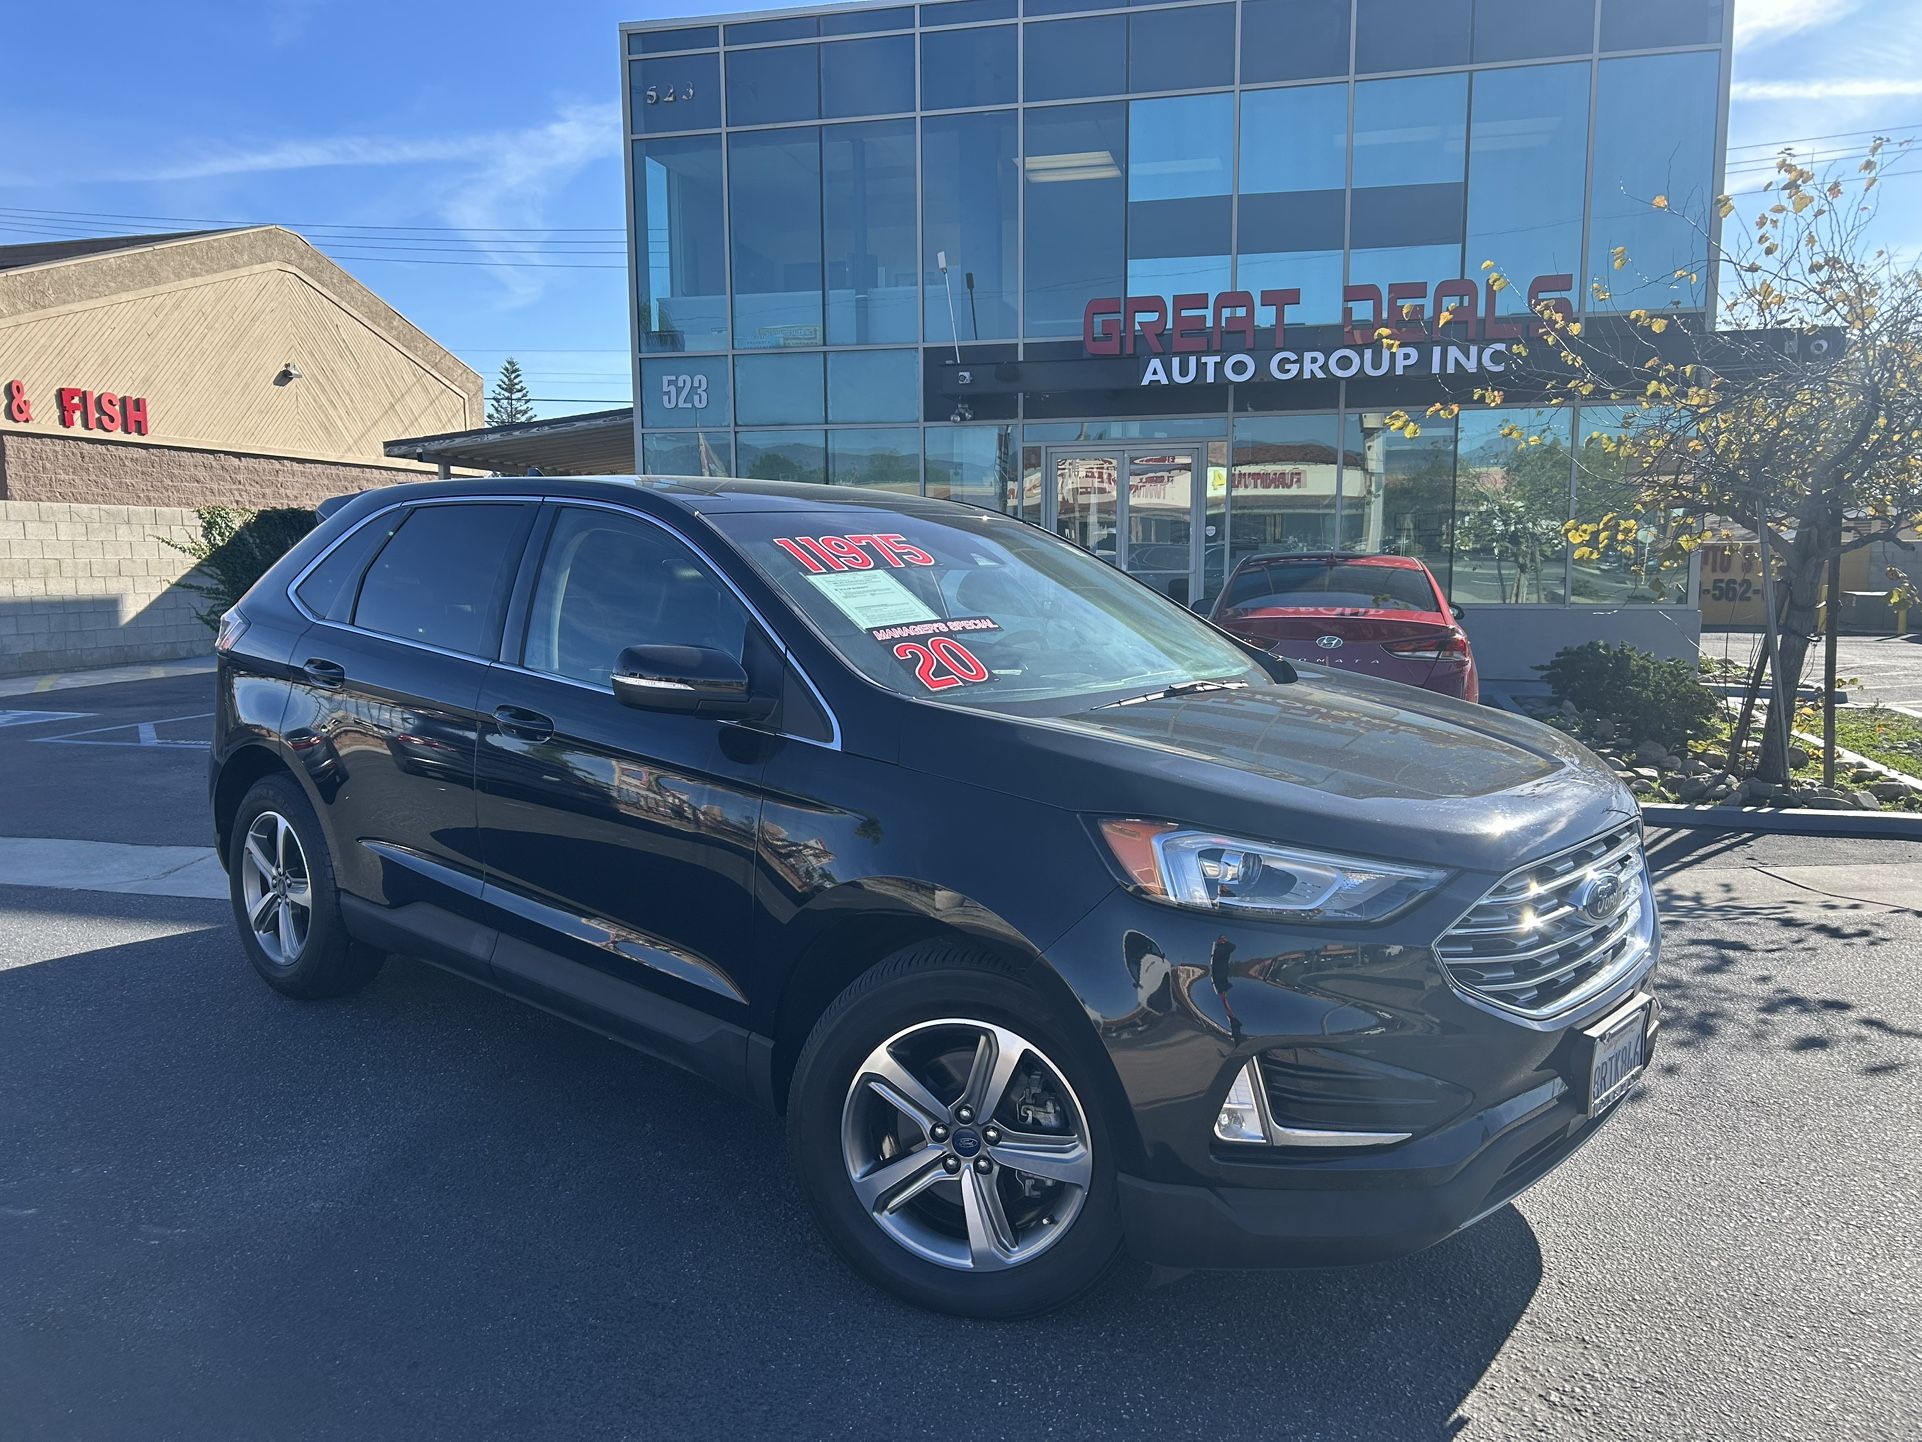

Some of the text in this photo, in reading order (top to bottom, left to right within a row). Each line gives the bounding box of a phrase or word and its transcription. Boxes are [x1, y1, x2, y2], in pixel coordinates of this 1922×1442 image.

[645, 79, 694, 104] 523
[1083, 273, 1574, 355] GREAT DEALS
[1140, 342, 1507, 386] AUTO GROUP INC
[4, 379, 149, 436] & FISH
[661, 374, 709, 410] 523
[773, 533, 935, 574] 11975
[872, 618, 999, 641] MANAGER'S SPECIAL
[893, 636, 989, 692] 20
